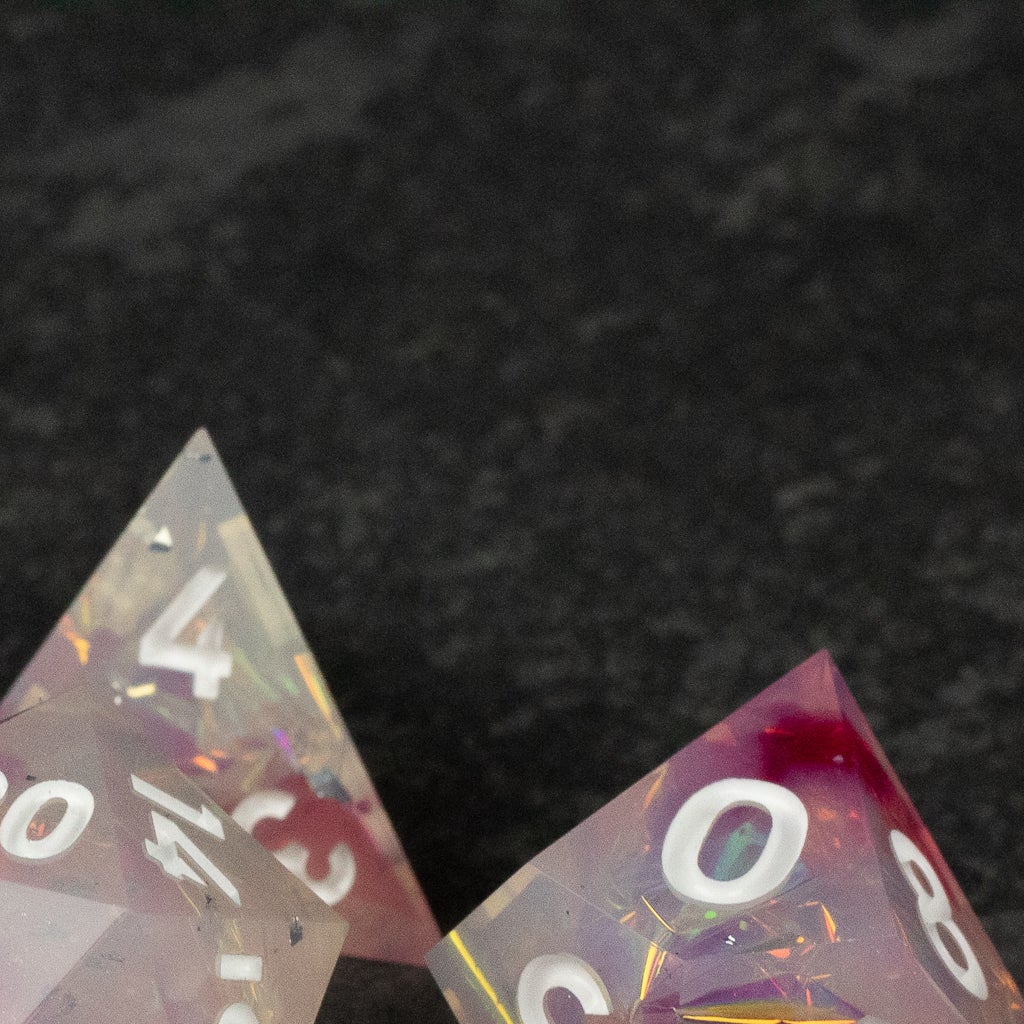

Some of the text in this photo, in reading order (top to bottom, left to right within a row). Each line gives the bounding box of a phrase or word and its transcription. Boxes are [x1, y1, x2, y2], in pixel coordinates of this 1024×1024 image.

[139, 567, 233, 700] 4
[230, 791, 357, 906] 3
[661, 777, 810, 905] 0
[889, 829, 989, 1001] 8
